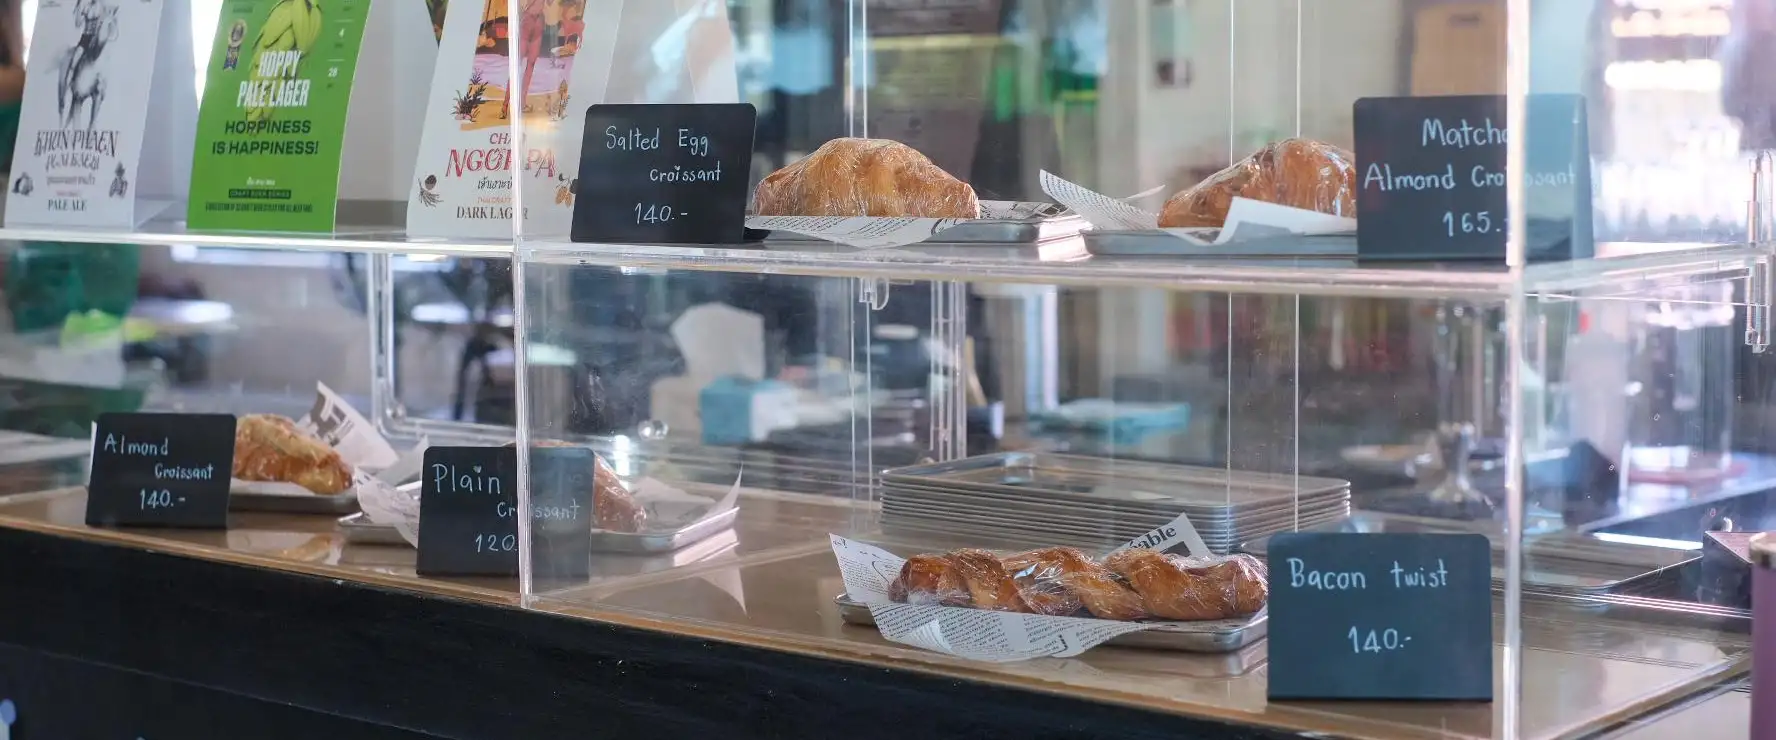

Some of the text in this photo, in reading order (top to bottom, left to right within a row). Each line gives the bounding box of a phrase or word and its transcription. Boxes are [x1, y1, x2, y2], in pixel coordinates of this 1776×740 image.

[257, 50, 302, 77] HOPPY
[237, 79, 311, 108] PALE LAGER
[212, 140, 319, 155] IS HAPPINESS!
[605, 125, 708, 157] Salted Egg
[1363, 162, 1456, 191] Almond
[456, 205, 529, 220] DARK LAGR
[634, 202, 688, 225] 140.-
[104, 432, 169, 457] Almond
[154, 462, 214, 480] Croissant
[431, 463, 501, 495] Plain
[1286, 557, 1449, 591] Bacon twist
[1348, 625, 1412, 654] 140.-
